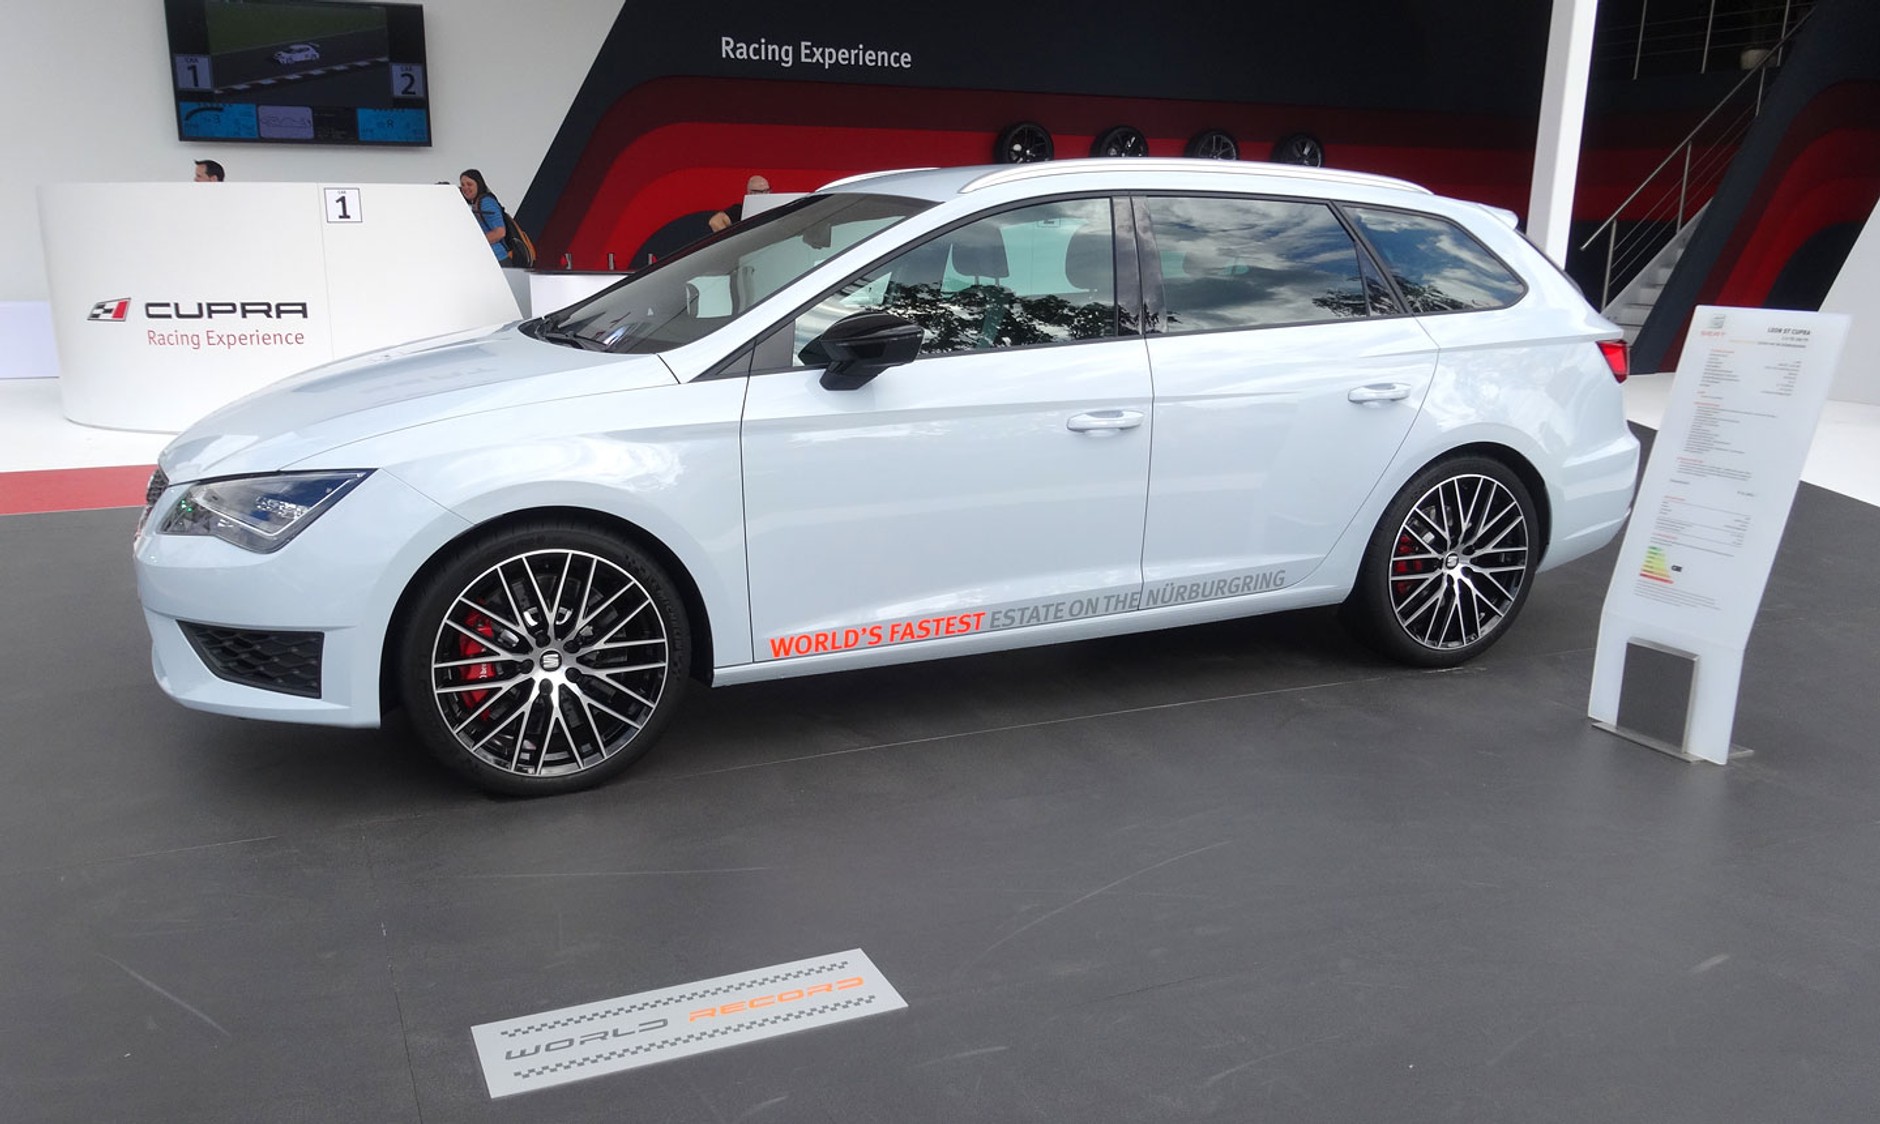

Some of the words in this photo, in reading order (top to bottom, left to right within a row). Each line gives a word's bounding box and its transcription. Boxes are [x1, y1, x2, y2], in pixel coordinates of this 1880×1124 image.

[721, 36, 793, 67] Racing
[800, 41, 912, 69] Experience
[186, 64, 200, 88] 1
[401, 72, 417, 95] 2
[335, 195, 351, 219] 1
[145, 302, 308, 319] CUPRA
[147, 330, 200, 350] Racing
[206, 329, 305, 349] Experience
[769, 625, 883, 658] WORLD'S
[889, 612, 986, 643] FASTEST
[989, 601, 1065, 629] ESTATE
[1068, 596, 1100, 618] ON
[1103, 592, 1141, 613] THE
[1146, 570, 1286, 606] NÜRBURGRING
[505, 1018, 669, 1061] WORLD
[688, 976, 865, 1022] RECORD
